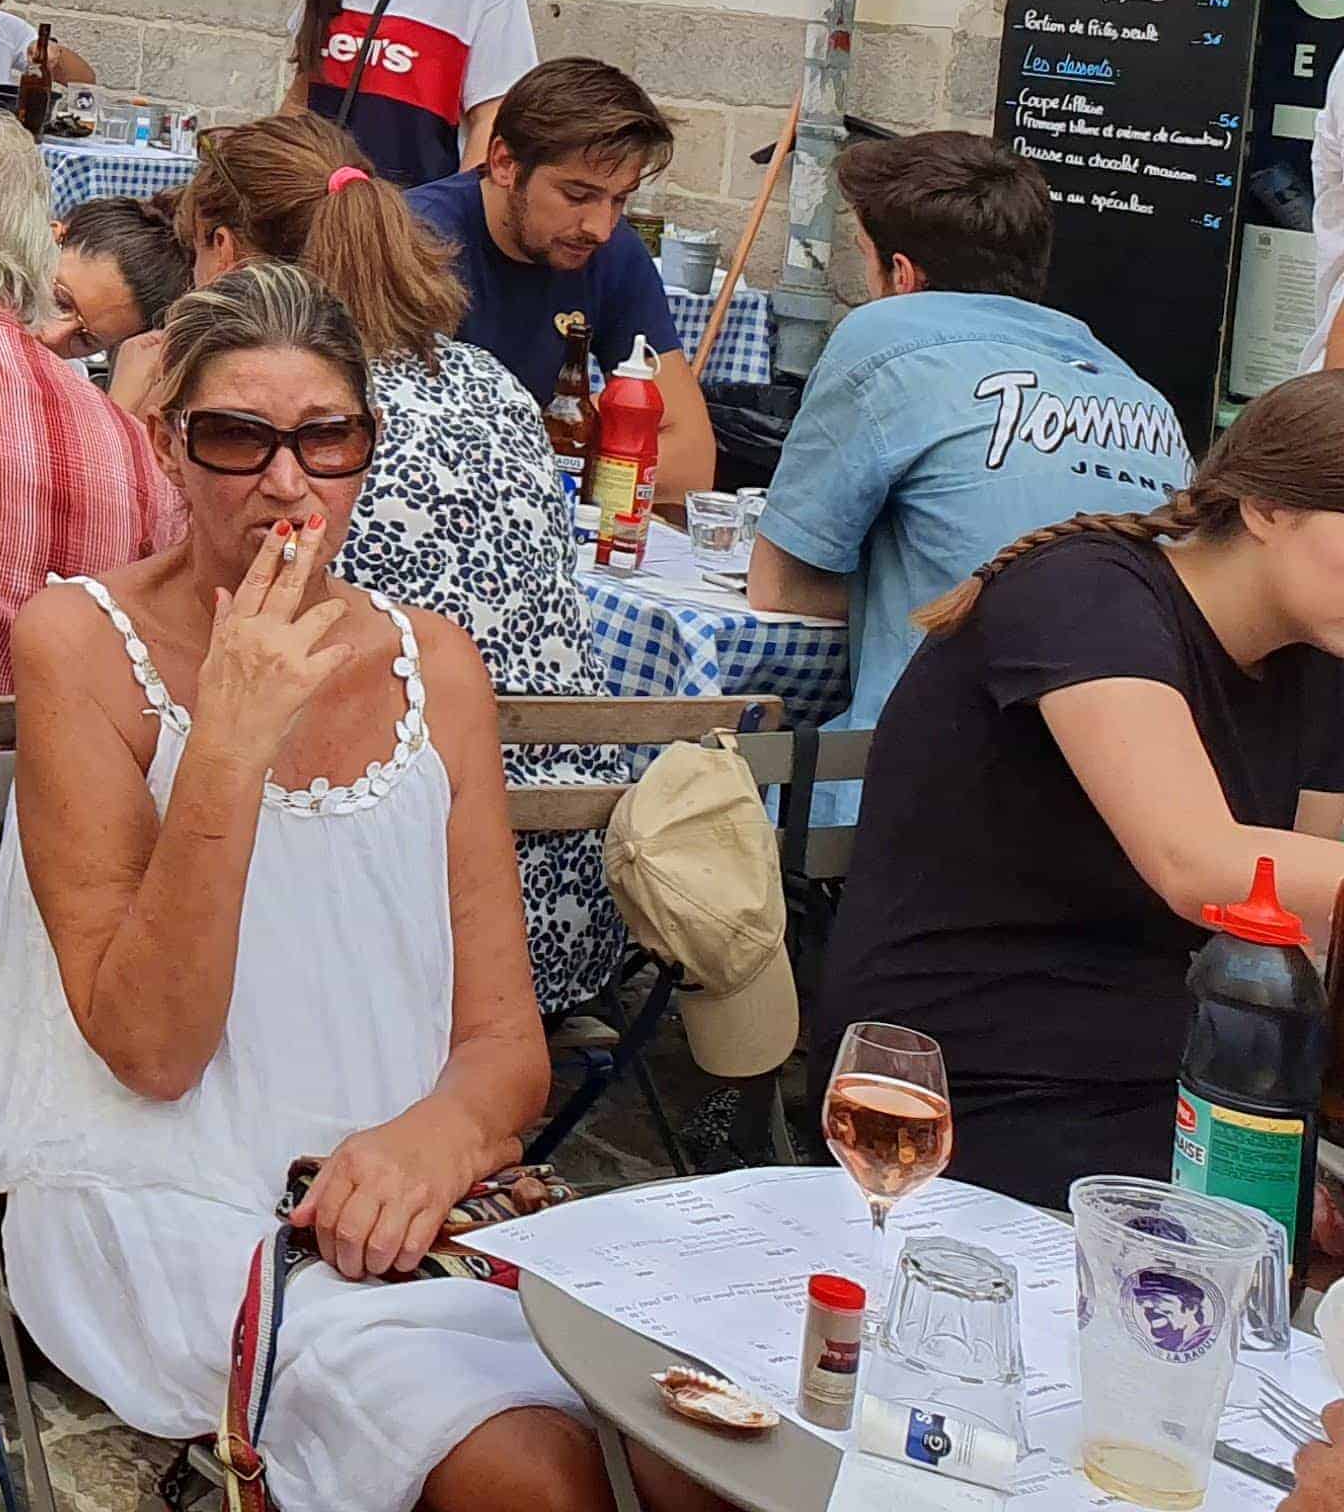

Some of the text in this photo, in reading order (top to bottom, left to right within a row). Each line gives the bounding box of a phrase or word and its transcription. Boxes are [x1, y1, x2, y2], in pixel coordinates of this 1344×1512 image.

[1024, 9, 1066, 33] Portion
[1068, 18, 1084, 35] de
[1022, 44, 1050, 71] Les
[1018, 88, 1060, 117] Coupe
[1219, 112, 1241, 129] 5€
[1069, 118, 1101, 137] blanc
[1152, 125, 1170, 143] de
[1012, 136, 1233, 187] Mousse au chocolat maison 5€
[1066, 191, 1086, 204] au
[1202, 214, 1223, 229] 5€
